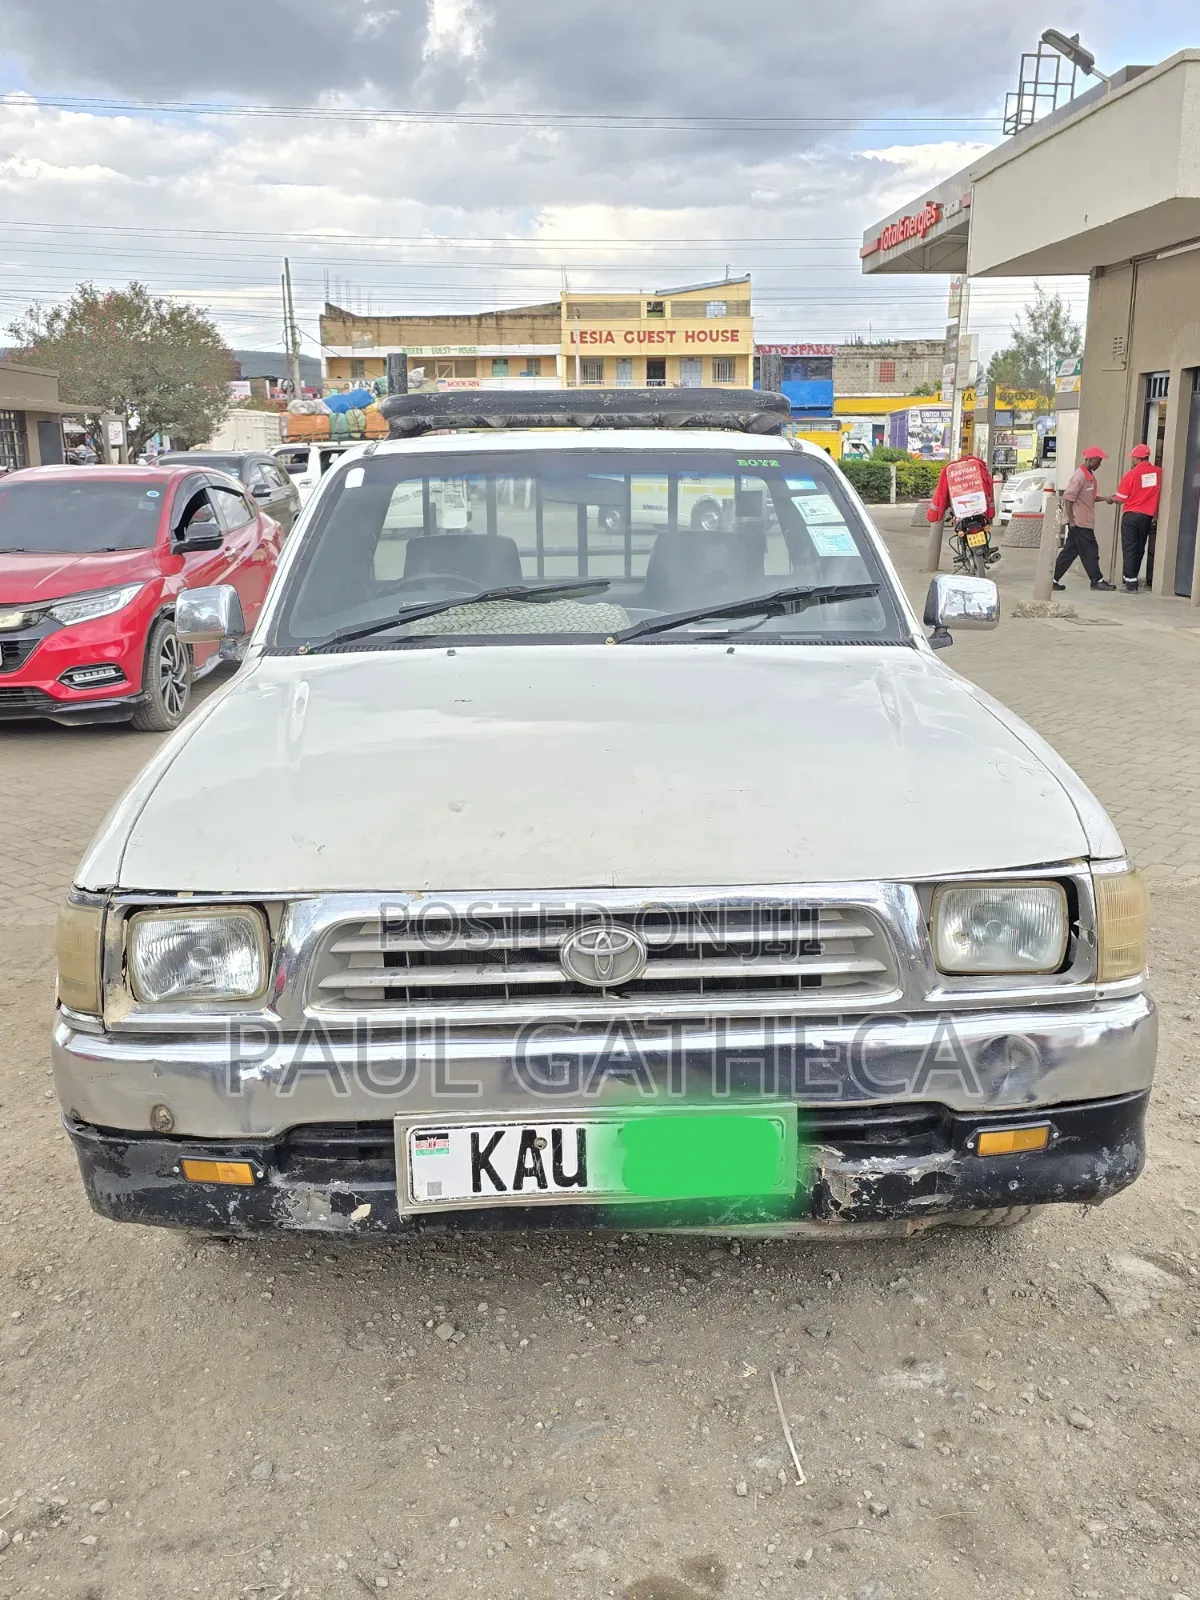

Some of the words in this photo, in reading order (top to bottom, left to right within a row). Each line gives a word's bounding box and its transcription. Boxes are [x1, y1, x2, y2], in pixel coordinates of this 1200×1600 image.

[881, 203, 938, 252] TotalEnergies
[570, 331, 615, 344] LESIA
[623, 330, 677, 344] GUEST
[685, 329, 740, 342] HOUSE
[431, 346, 451, 355] GUEST
[755, 345, 789, 355] AUTO
[790, 344, 837, 355] SPARES
[447, 380, 480, 388] MODERN
[470, 1127, 588, 1193] KAU
